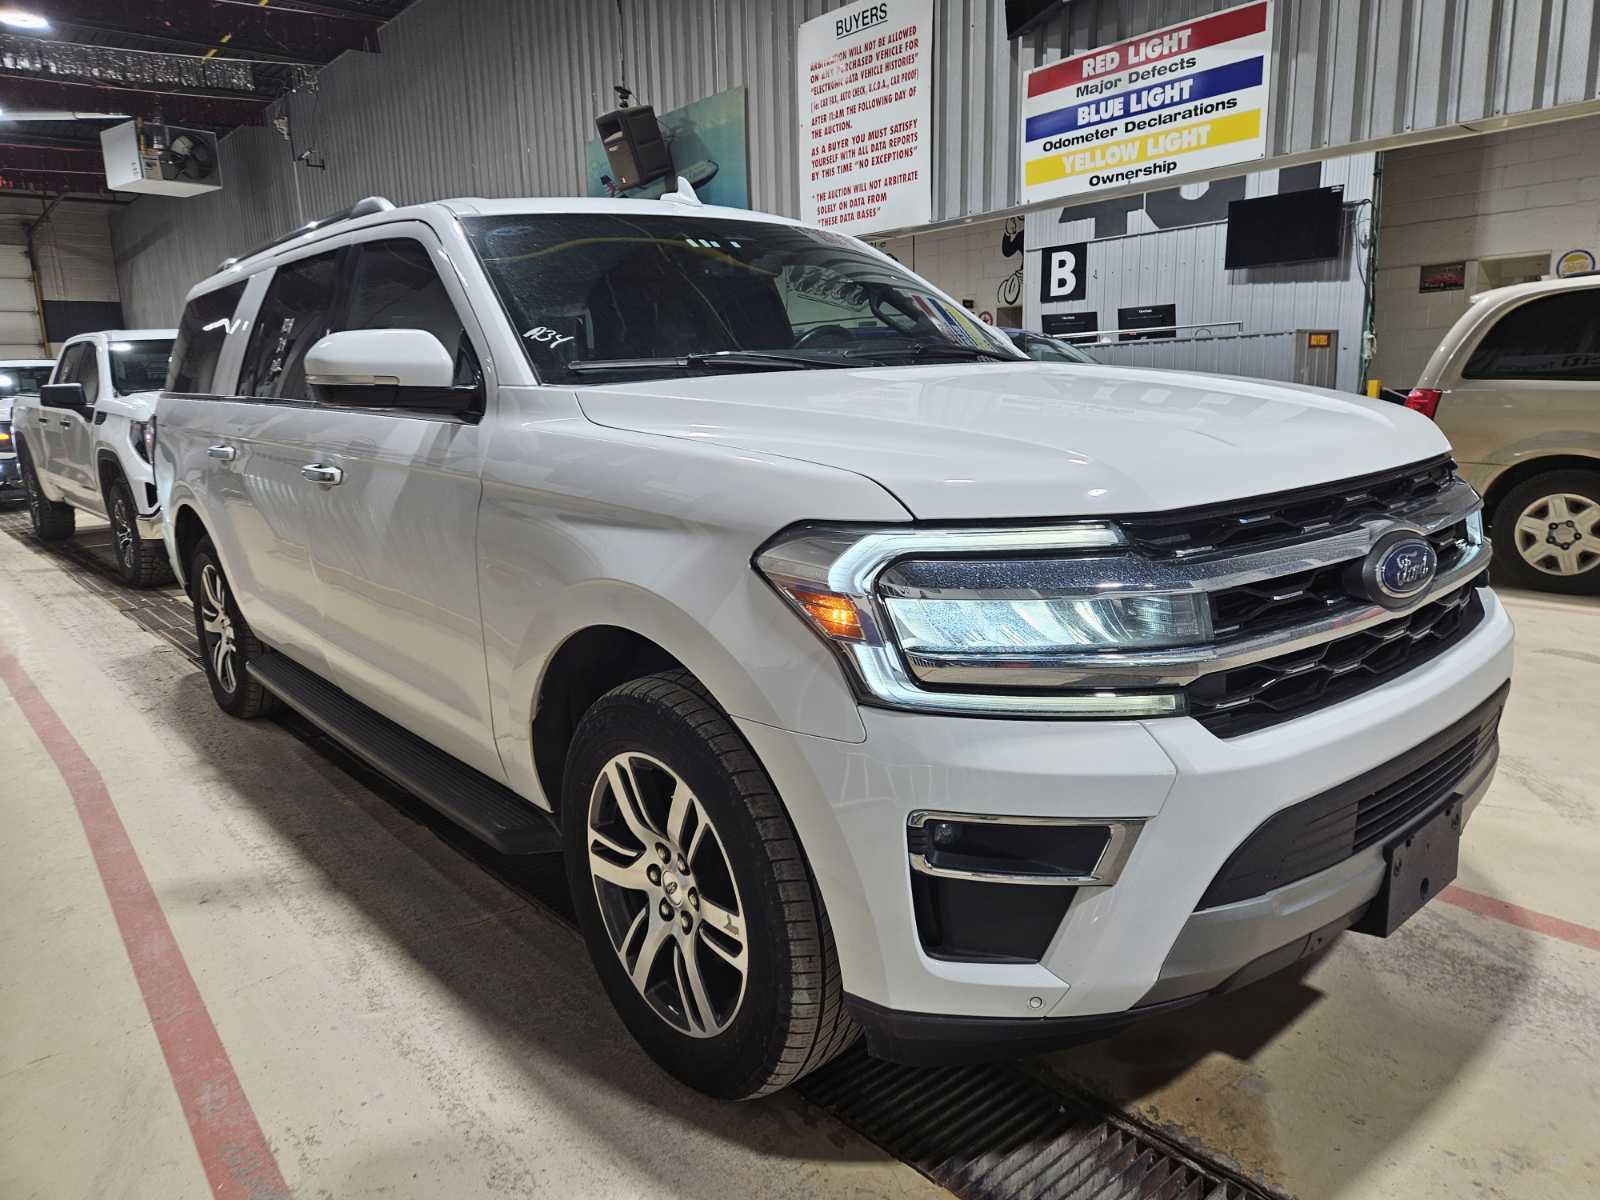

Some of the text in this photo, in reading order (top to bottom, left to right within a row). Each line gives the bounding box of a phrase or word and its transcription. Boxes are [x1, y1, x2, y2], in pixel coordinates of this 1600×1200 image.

[836, 3, 888, 37] BUYERS
[810, 25, 917, 71] ARBITTION WILL NOT BE ALLOWED
[810, 74, 819, 84] ON
[876, 45, 903, 61] VEHICLE
[905, 39, 919, 51] FOR
[1082, 28, 1192, 78] RED LIGHT
[861, 64, 883, 79] VEHICLE
[1076, 55, 1197, 99] Major Defects
[811, 113, 827, 126] AFTER
[846, 105, 857, 116] THE
[858, 94, 893, 112] FOLLOWING
[895, 90, 906, 101] DAY
[909, 86, 917, 97] OF
[1077, 79, 1194, 126] BLUE LIGHT
[811, 120, 852, 139] THE AUCTION.
[811, 119, 918, 156] AS A BUYER YOU MUST SATISFY
[1043, 97, 1238, 152] Odometer Declarations
[811, 132, 918, 169] YOURSELF WITH ALL DATA REPORTS
[1062, 124, 1211, 174] YELLOW LIGHT
[811, 172, 820, 181] BY
[821, 168, 835, 178] THIS
[837, 163, 852, 174] TIME
[816, 170, 918, 202] THE AUCTION WILL NOT ARBITRATE
[1089, 160, 1178, 187] Ownership
[817, 192, 888, 216] SOLELY ON DATA FROM
[839, 211, 855, 221] DATA
[1050, 250, 1077, 297] B
[1396, 551, 1429, 586] Ford
